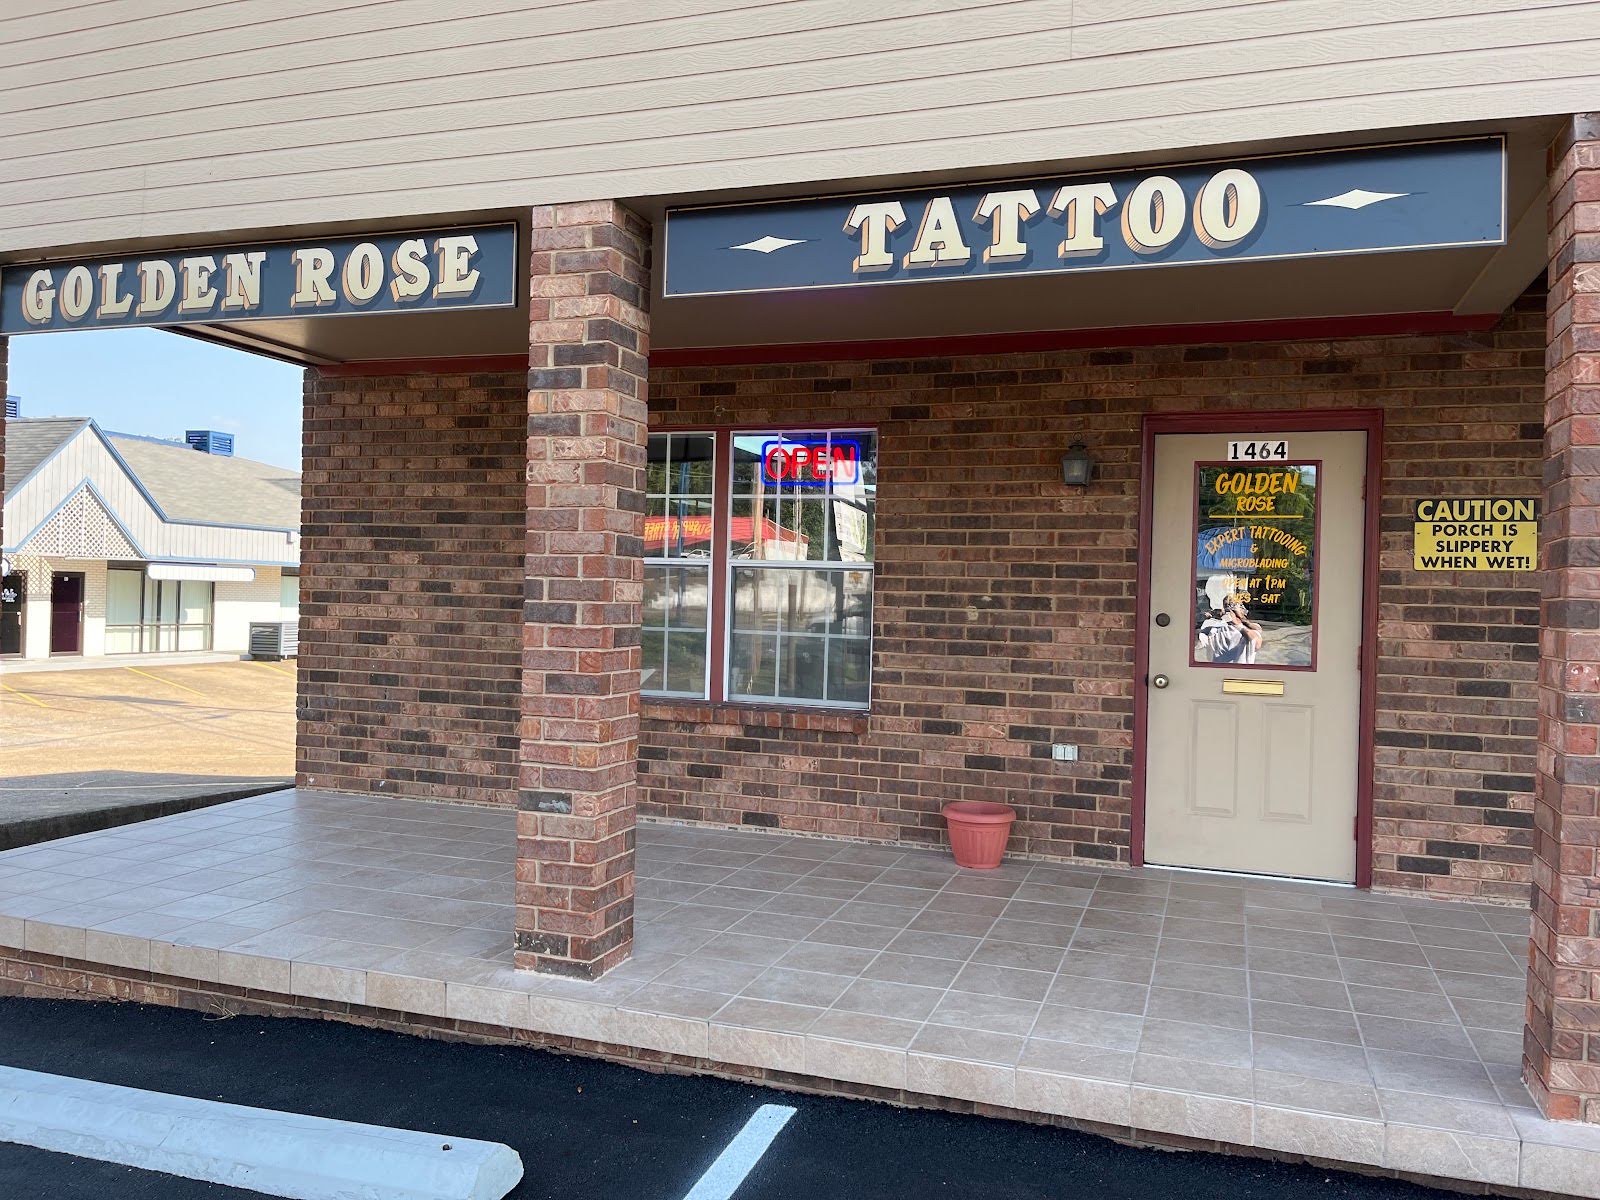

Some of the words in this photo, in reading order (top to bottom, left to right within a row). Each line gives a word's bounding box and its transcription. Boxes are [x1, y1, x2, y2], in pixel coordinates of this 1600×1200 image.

[842, 168, 1262, 274] TATTOO
[22, 251, 267, 326] GOLDEN
[290, 235, 481, 308] ROSE
[1231, 441, 1287, 460] 1464
[765, 446, 856, 480] OPEN
[1215, 472, 1299, 495] GOLDEN
[1236, 496, 1277, 512] ROSE
[1417, 499, 1535, 521] CAUTION
[1432, 524, 1493, 536] PORCH
[1502, 524, 1518, 536] IS
[1205, 526, 1246, 555] EXPERT
[1249, 525, 1307, 556] TATTOOING
[1249, 543, 1259, 554] &
[1436, 540, 1514, 553] SLIPPERY
[1220, 558, 1289, 569] MICROBLADING
[1421, 556, 1477, 568] WHEN
[1486, 556, 1530, 569] WET!
[1249, 578, 1262, 589] AT
[1260, 593, 1281, 604] SAT
